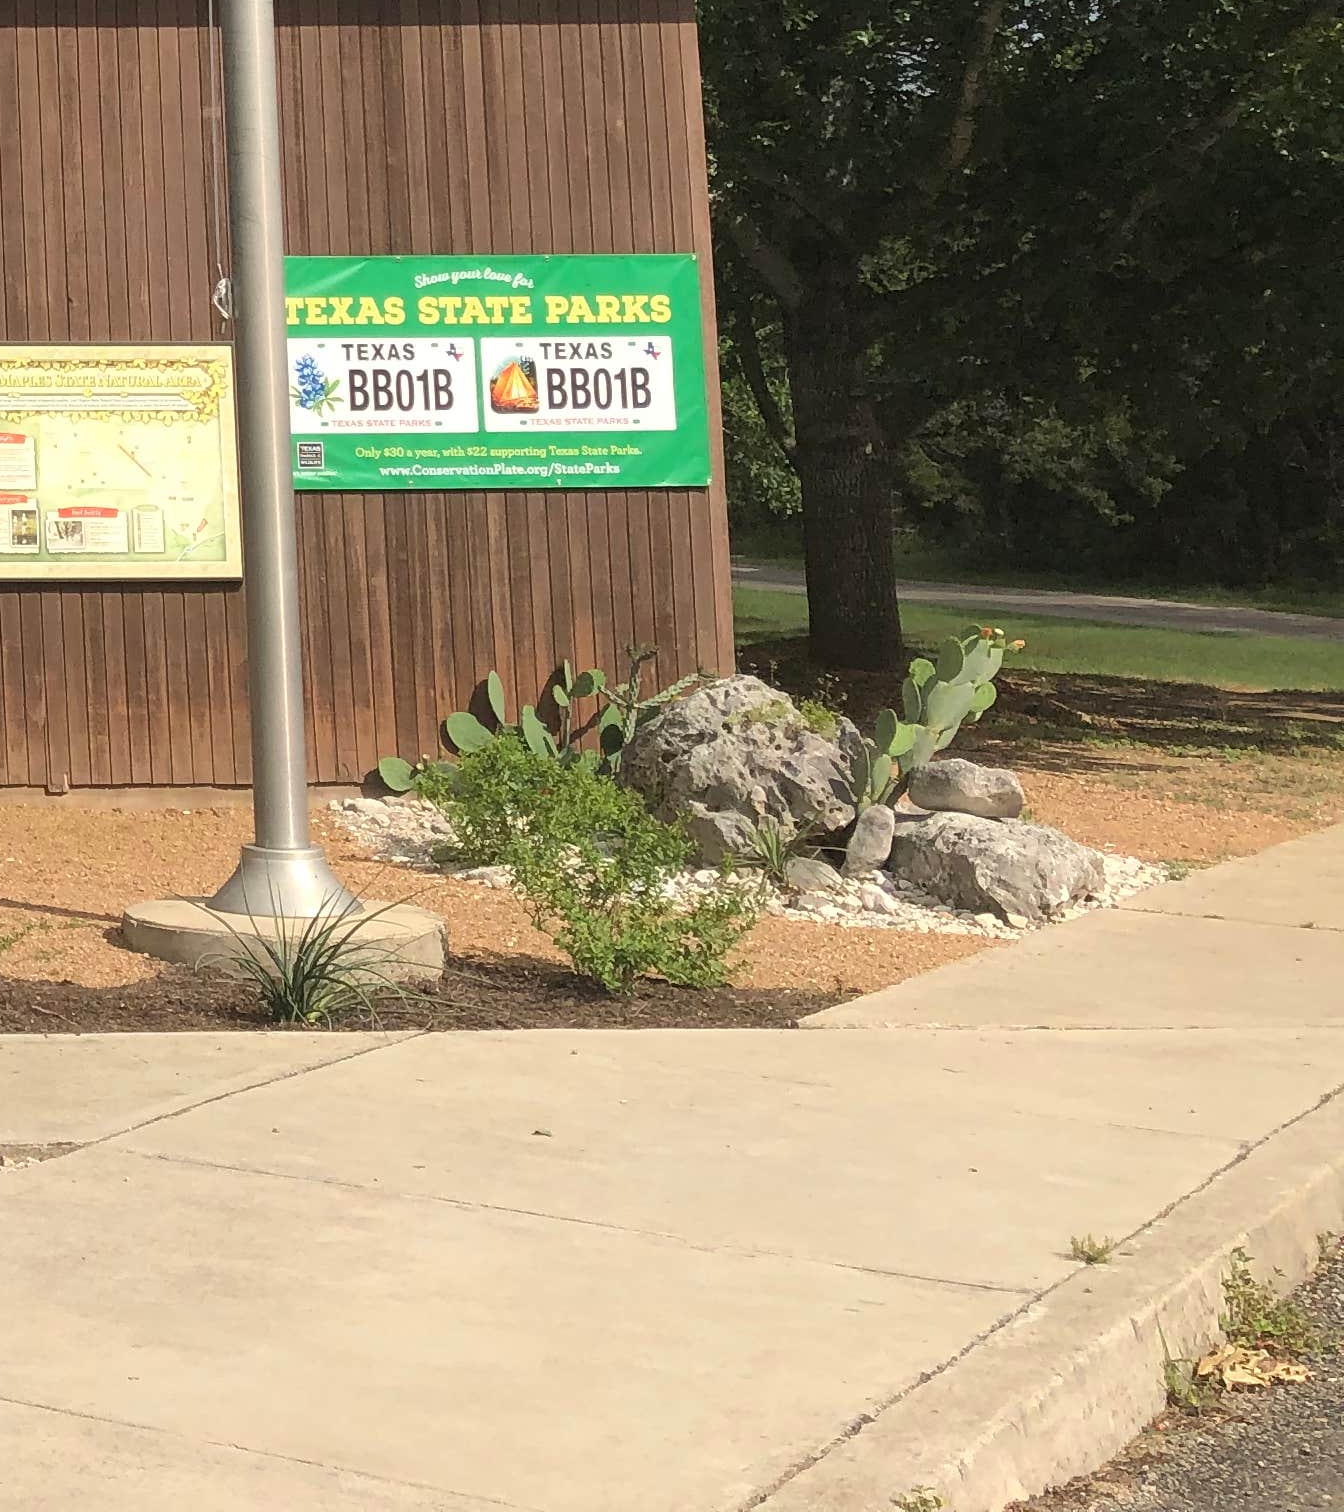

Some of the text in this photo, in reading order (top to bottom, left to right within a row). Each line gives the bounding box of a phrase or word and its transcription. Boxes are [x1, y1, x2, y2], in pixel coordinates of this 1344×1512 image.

[414, 267, 534, 289] Show your love for
[285, 294, 672, 325] TEXAS STATE PARKS
[341, 343, 415, 361] TEXAS
[539, 342, 613, 360] TEXAS
[348, 368, 454, 412] BB01B
[546, 367, 652, 410] BB01B
[366, 419, 396, 427] STATE
[531, 418, 562, 426] TEXAS
[597, 417, 629, 425] PARKS
[355, 447, 381, 459] Only
[383, 447, 404, 457] $30
[415, 449, 440, 459] year,
[442, 446, 465, 457] with
[467, 446, 487, 457] $22
[489, 446, 547, 459] supporting
[549, 445, 579, 456] Texas
[581, 445, 608, 456] State
[610, 444, 642, 456] Parks.
[379, 462, 620, 477] www.ConservationPlate.org/StateParks
